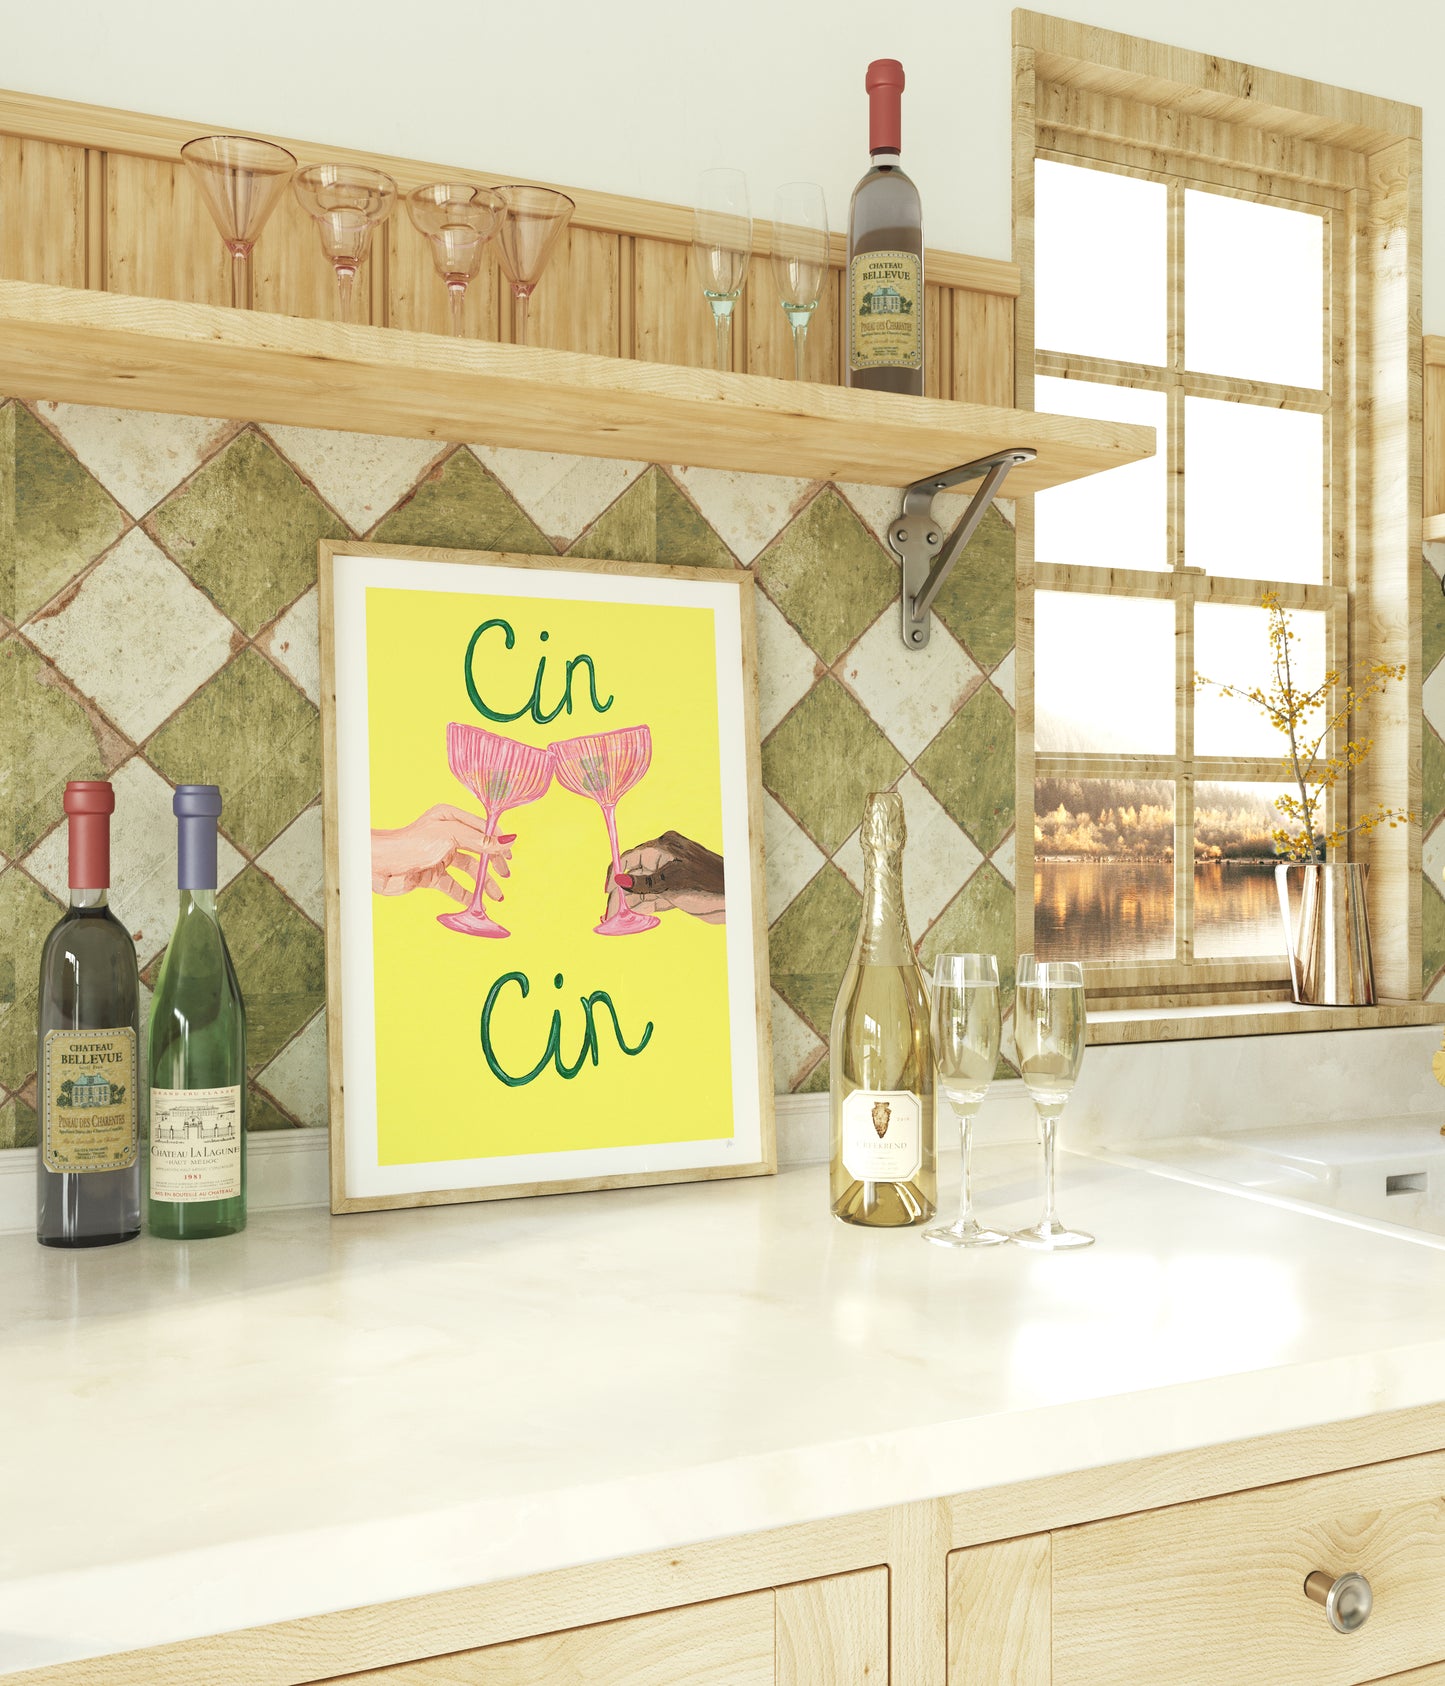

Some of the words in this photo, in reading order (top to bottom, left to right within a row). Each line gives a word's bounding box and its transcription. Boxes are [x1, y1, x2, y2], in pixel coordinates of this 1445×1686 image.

[869, 262, 903, 270] CHATEAU
[862, 270, 911, 281] BELLEVUE
[464, 618, 614, 725] Cin
[480, 971, 654, 1088] Cin
[69, 1043, 113, 1052] CHATEAU
[61, 1052, 123, 1065] BELLEVUE
[91, 1114, 126, 1128] CHARENTES
[151, 1145, 188, 1158] CHATEAU
[190, 1147, 202, 1158] LA
[203, 1146, 240, 1157] LAGUNE
